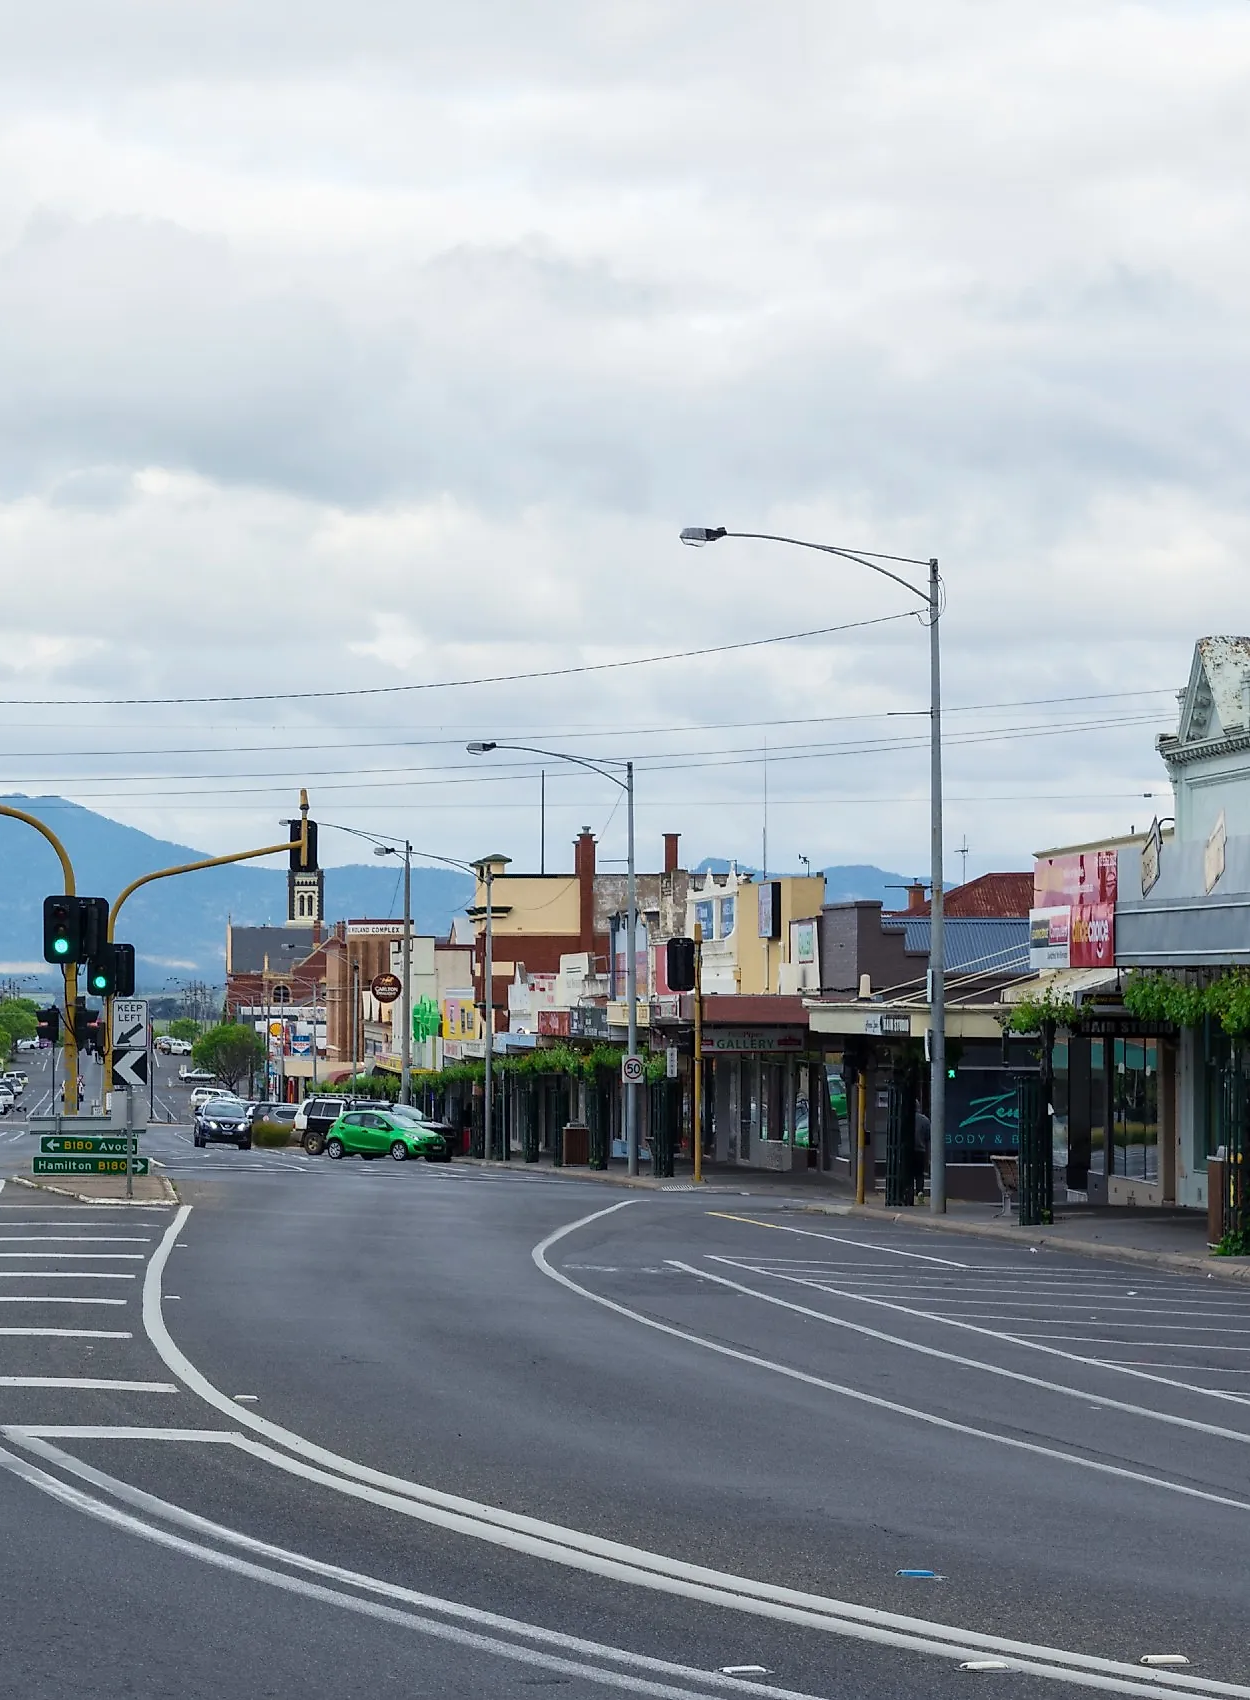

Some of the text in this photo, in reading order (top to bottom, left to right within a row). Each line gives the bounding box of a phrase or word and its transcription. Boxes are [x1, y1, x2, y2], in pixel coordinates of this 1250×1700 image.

[117, 1004, 143, 1012] KEEP
[118, 1014, 142, 1022] LEFT
[1081, 1021, 1174, 1034] HAIR STUDIO
[716, 1039, 775, 1050] GALLERY
[626, 1063, 641, 1074] 50
[64, 1141, 136, 1151] B180 Avoca
[38, 1160, 127, 1171] Hamilton B180
